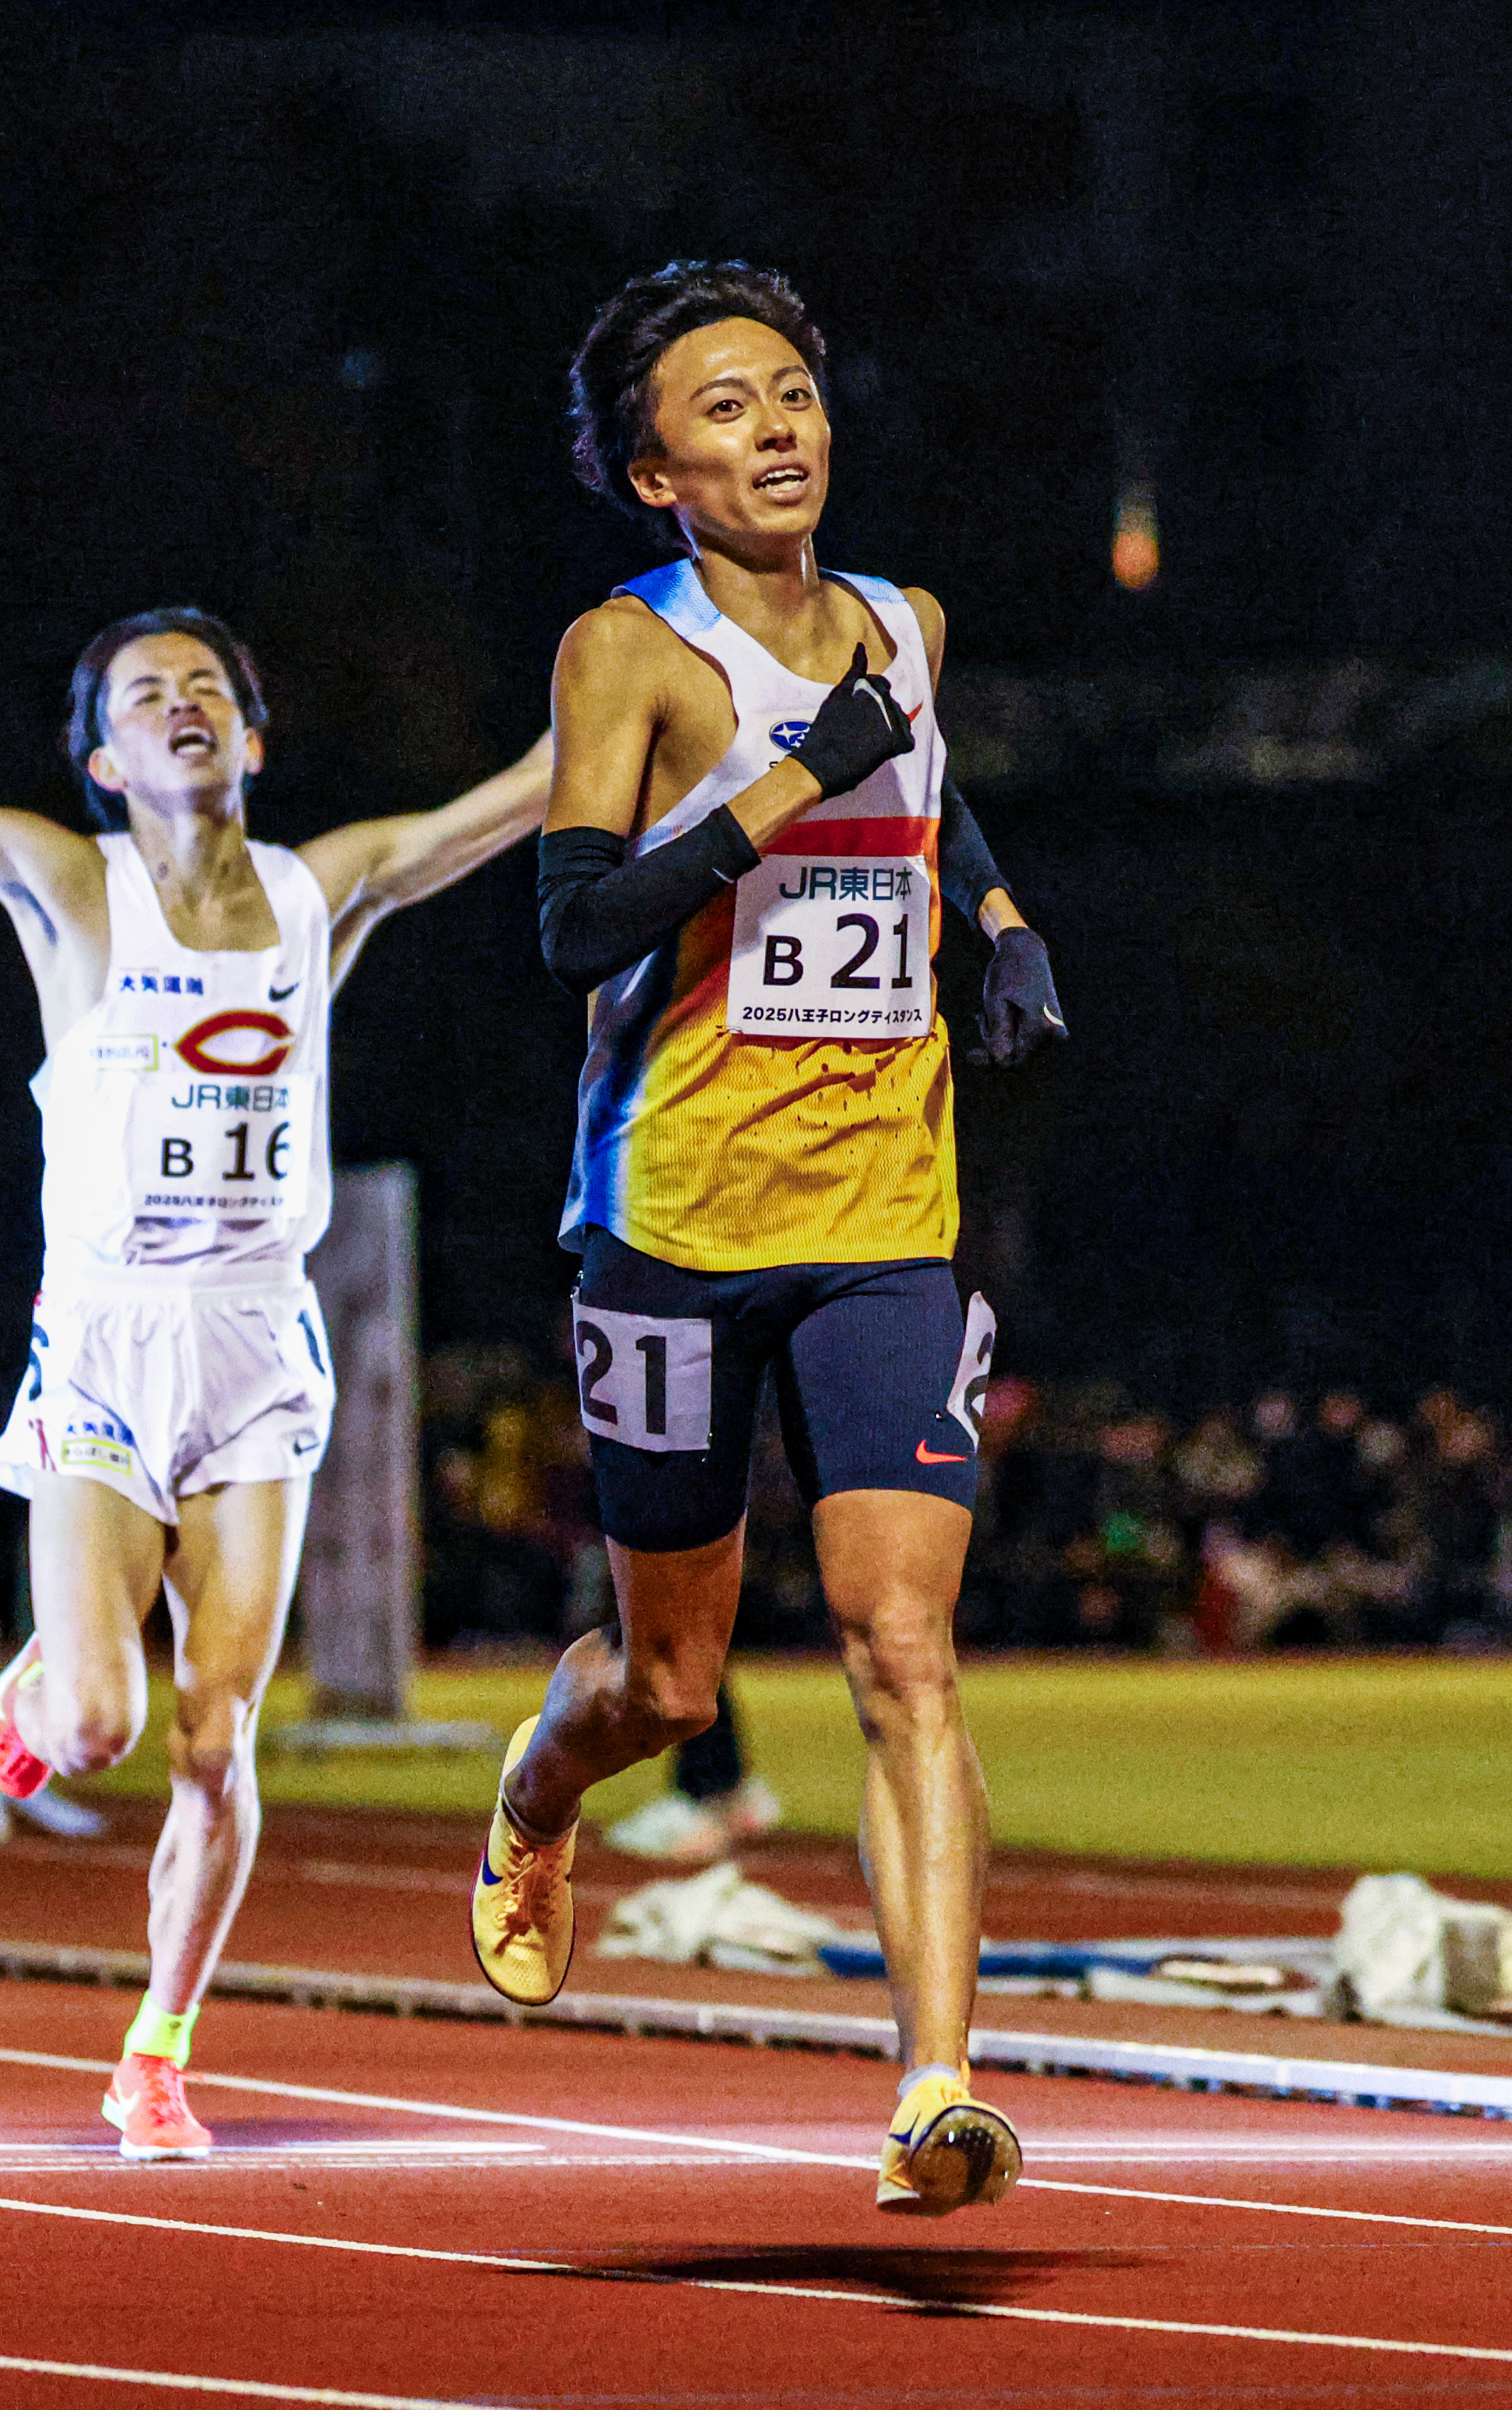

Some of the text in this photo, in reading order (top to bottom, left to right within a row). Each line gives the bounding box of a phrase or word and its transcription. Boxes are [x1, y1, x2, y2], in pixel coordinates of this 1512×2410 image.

[779, 867, 912, 901] JR東日本
[763, 913, 912, 989] B 21
[743, 1006, 922, 1024] 2025八王子ロングディスタンス
[161, 1138, 194, 1178] B
[576, 1320, 666, 1435] 21
